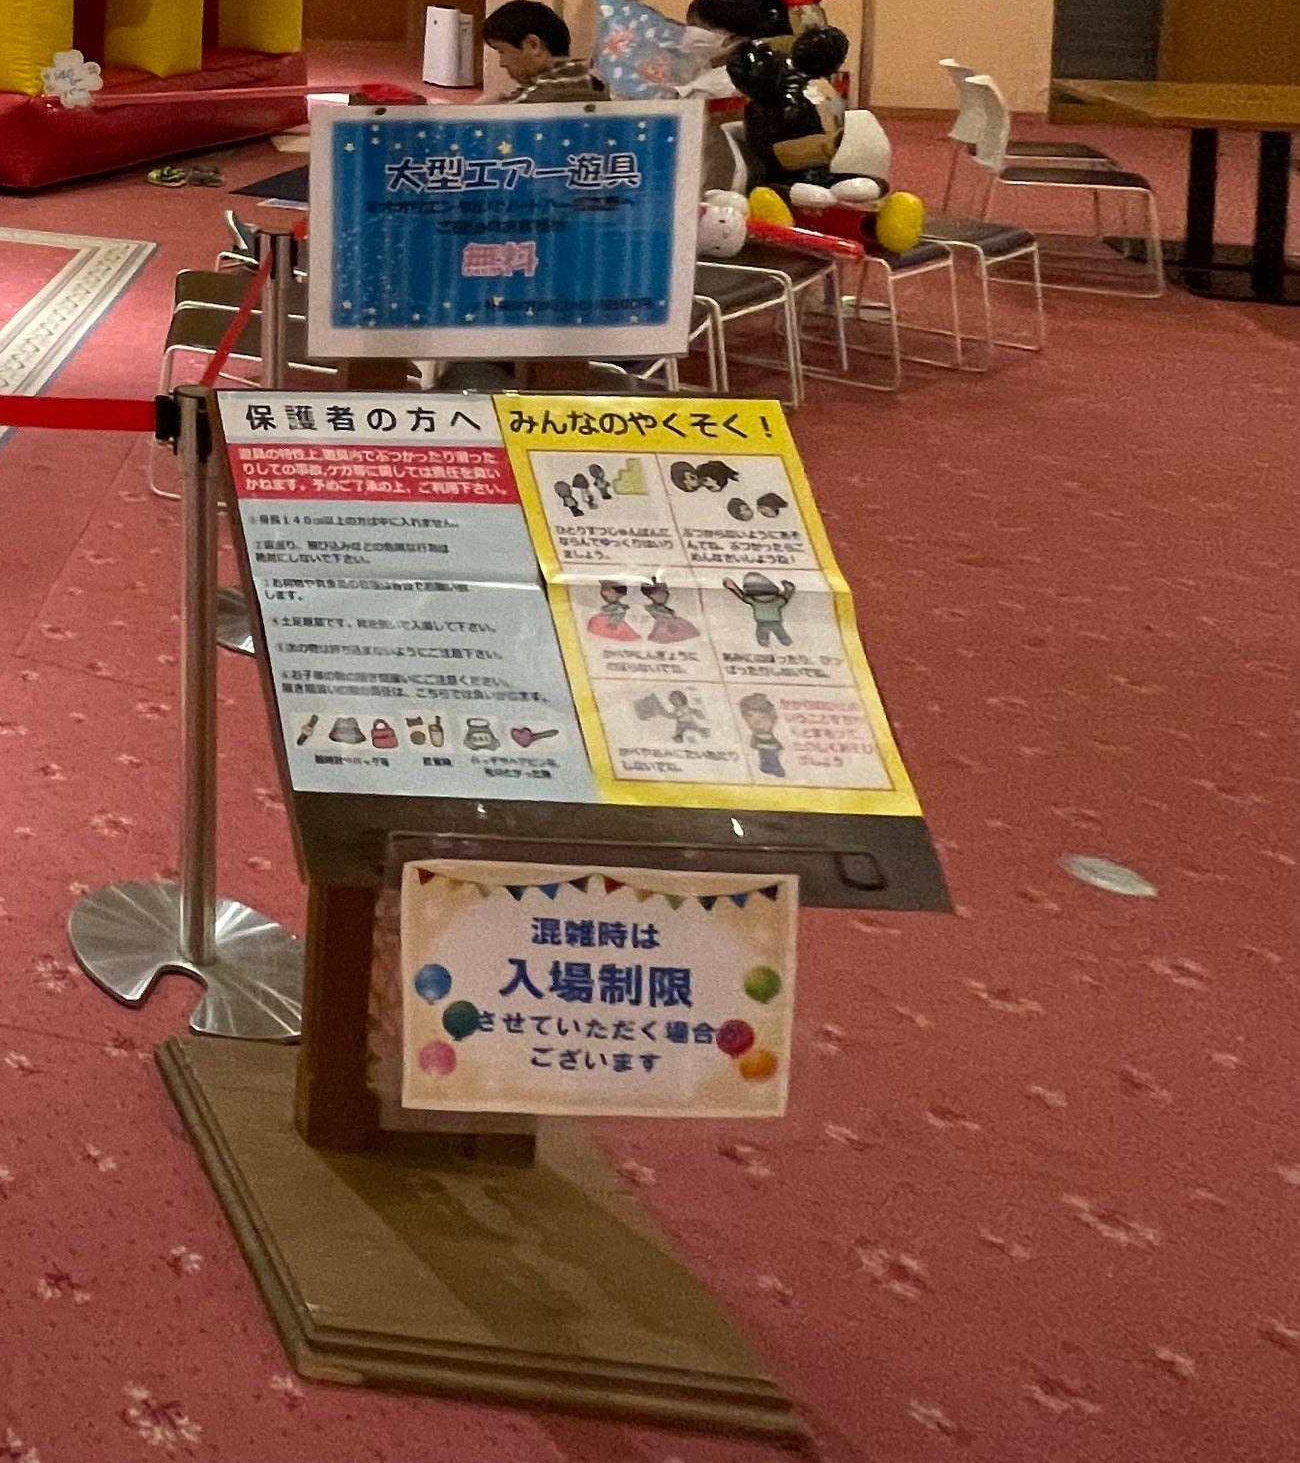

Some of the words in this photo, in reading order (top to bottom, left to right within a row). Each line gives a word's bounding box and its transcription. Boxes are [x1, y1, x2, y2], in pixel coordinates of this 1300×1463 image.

[386, 153, 641, 192] 大型エアー遊具
[462, 241, 538, 277] 無料
[246, 404, 482, 433] 保護者の方へ
[510, 410, 773, 438] みんなのやくそく!
[531, 917, 660, 950] 混雑時は
[499, 956, 694, 1008] 入場制限
[530, 1046, 662, 1073] ございます
